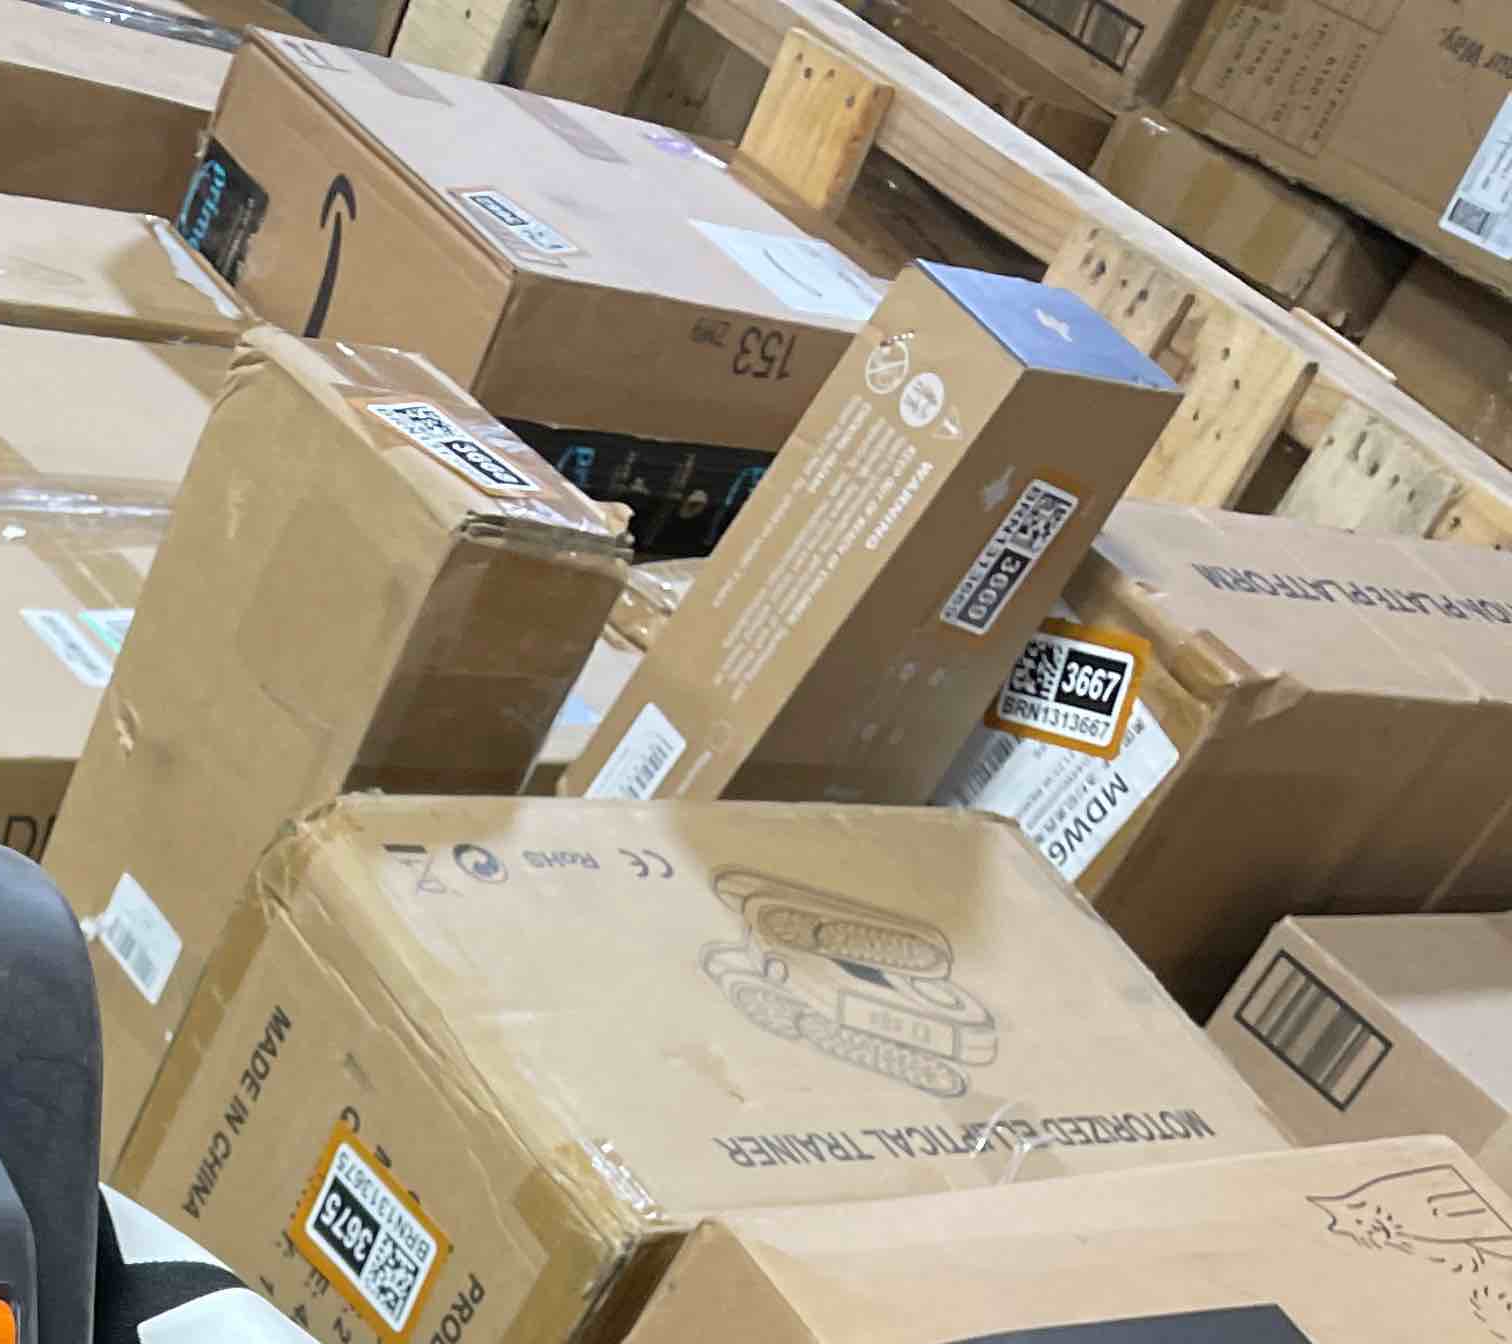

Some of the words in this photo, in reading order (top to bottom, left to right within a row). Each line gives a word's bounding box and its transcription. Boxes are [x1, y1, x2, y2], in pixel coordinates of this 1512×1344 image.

[733, 326, 799, 381] 153
[1061, 661, 1121, 703] 3667
[1002, 695, 1111, 740] BRN1313667
[1047, 770, 1130, 868] MDW6
[241, 1004, 292, 1102] MADE
[223, 1099, 250, 1136] IN
[1041, 1108, 1217, 1147] MOTORIZED
[182, 1131, 233, 1220] CHINA
[712, 1131, 876, 1168] TRAINER
[320, 1191, 376, 1261] 3675
[336, 1150, 429, 1264] BRN1313675
